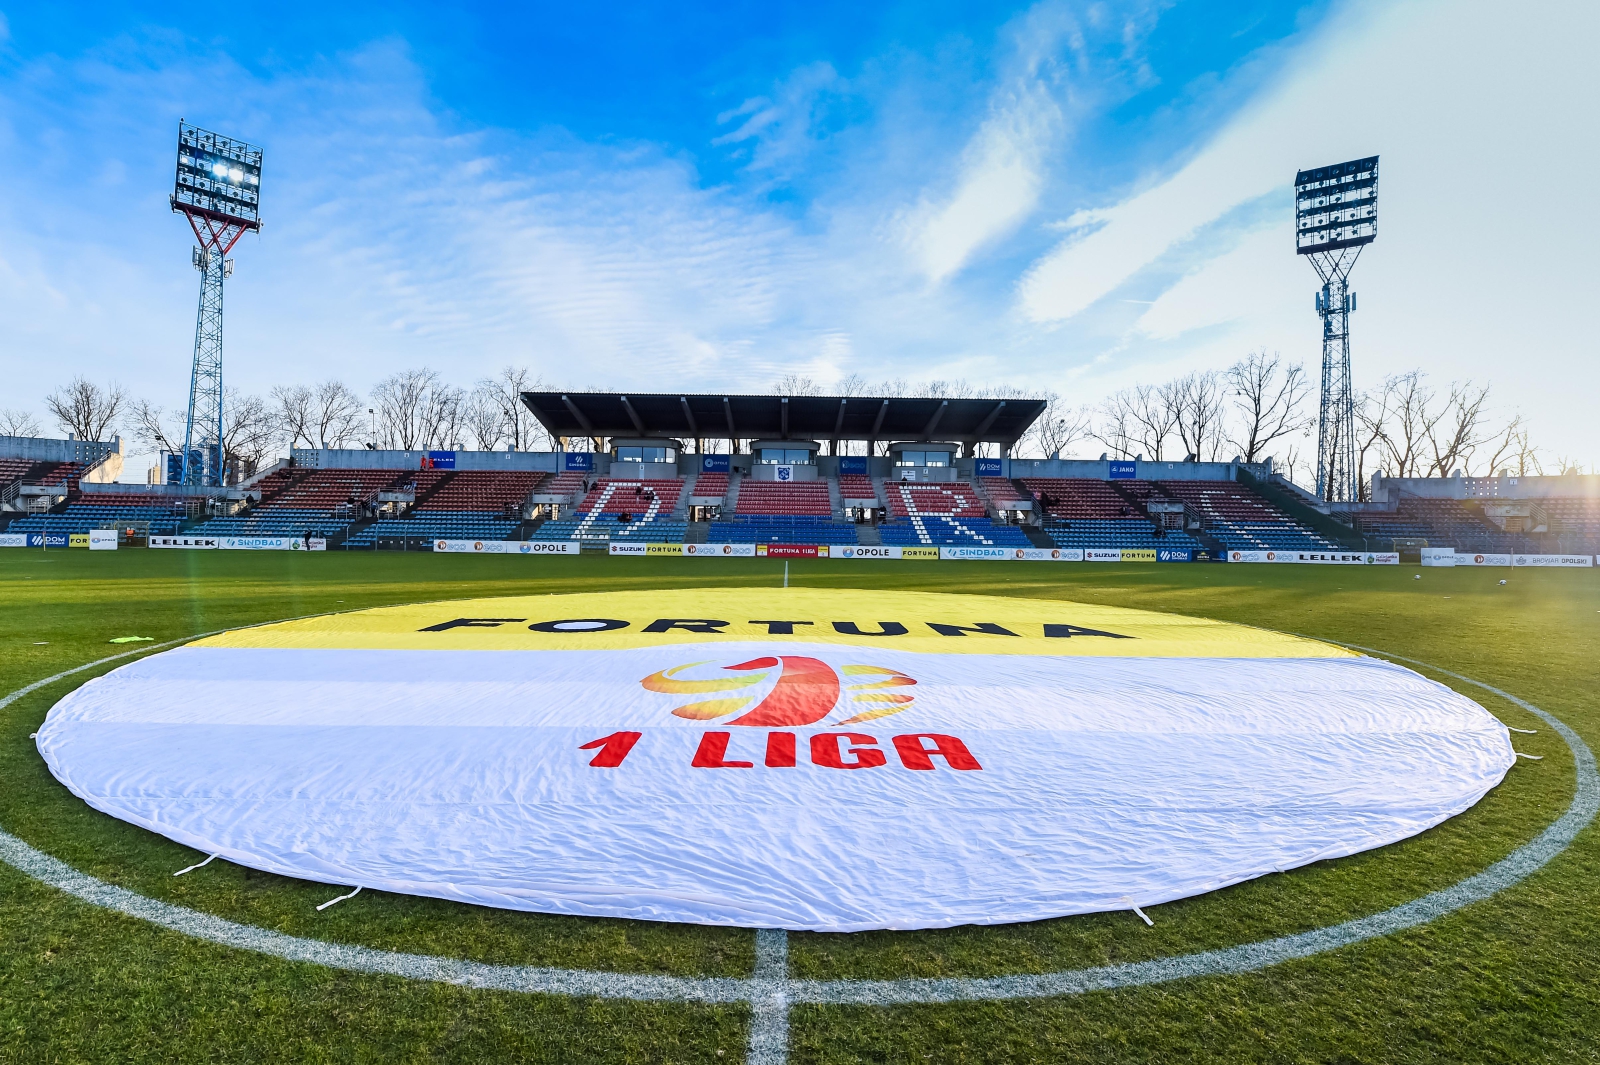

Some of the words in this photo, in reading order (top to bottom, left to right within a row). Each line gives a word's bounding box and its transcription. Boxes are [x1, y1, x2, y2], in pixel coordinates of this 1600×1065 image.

[533, 544, 567, 552] OPOLE
[856, 548, 889, 556] OPOLE
[1298, 554, 1363, 562] LELLEK
[1561, 557, 1587, 565] OPOLSKI
[417, 617, 1142, 640] FORTUNA
[578, 731, 643, 769] 1
[690, 731, 982, 772] LIGA
